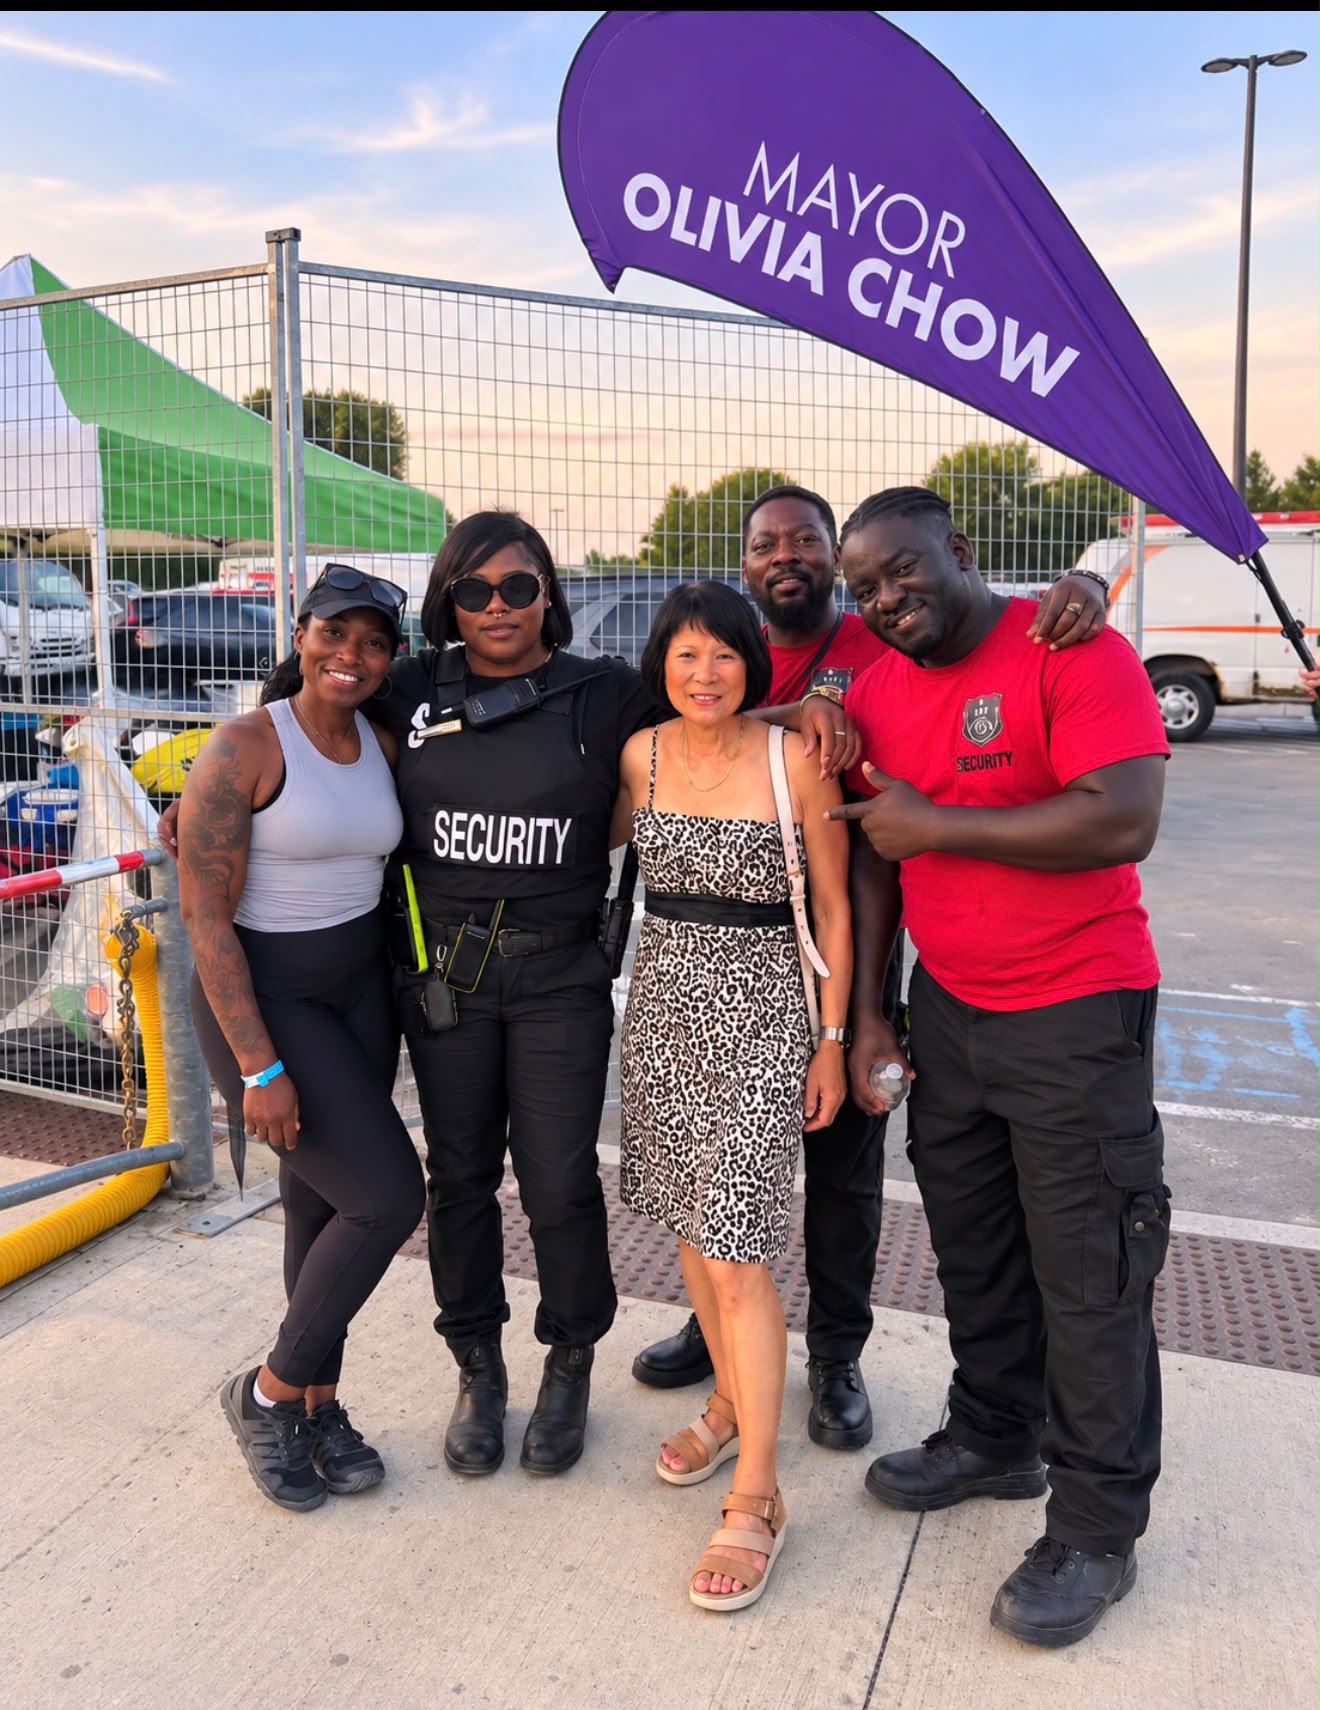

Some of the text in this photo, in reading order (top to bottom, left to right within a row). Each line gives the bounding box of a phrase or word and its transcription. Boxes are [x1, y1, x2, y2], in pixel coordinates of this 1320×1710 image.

[743, 141, 966, 279] MAYOR
[623, 172, 1081, 398] OLIVIA CHOW
[956, 751, 1013, 773] SECURITY
[433, 809, 573, 866] SECURITY
